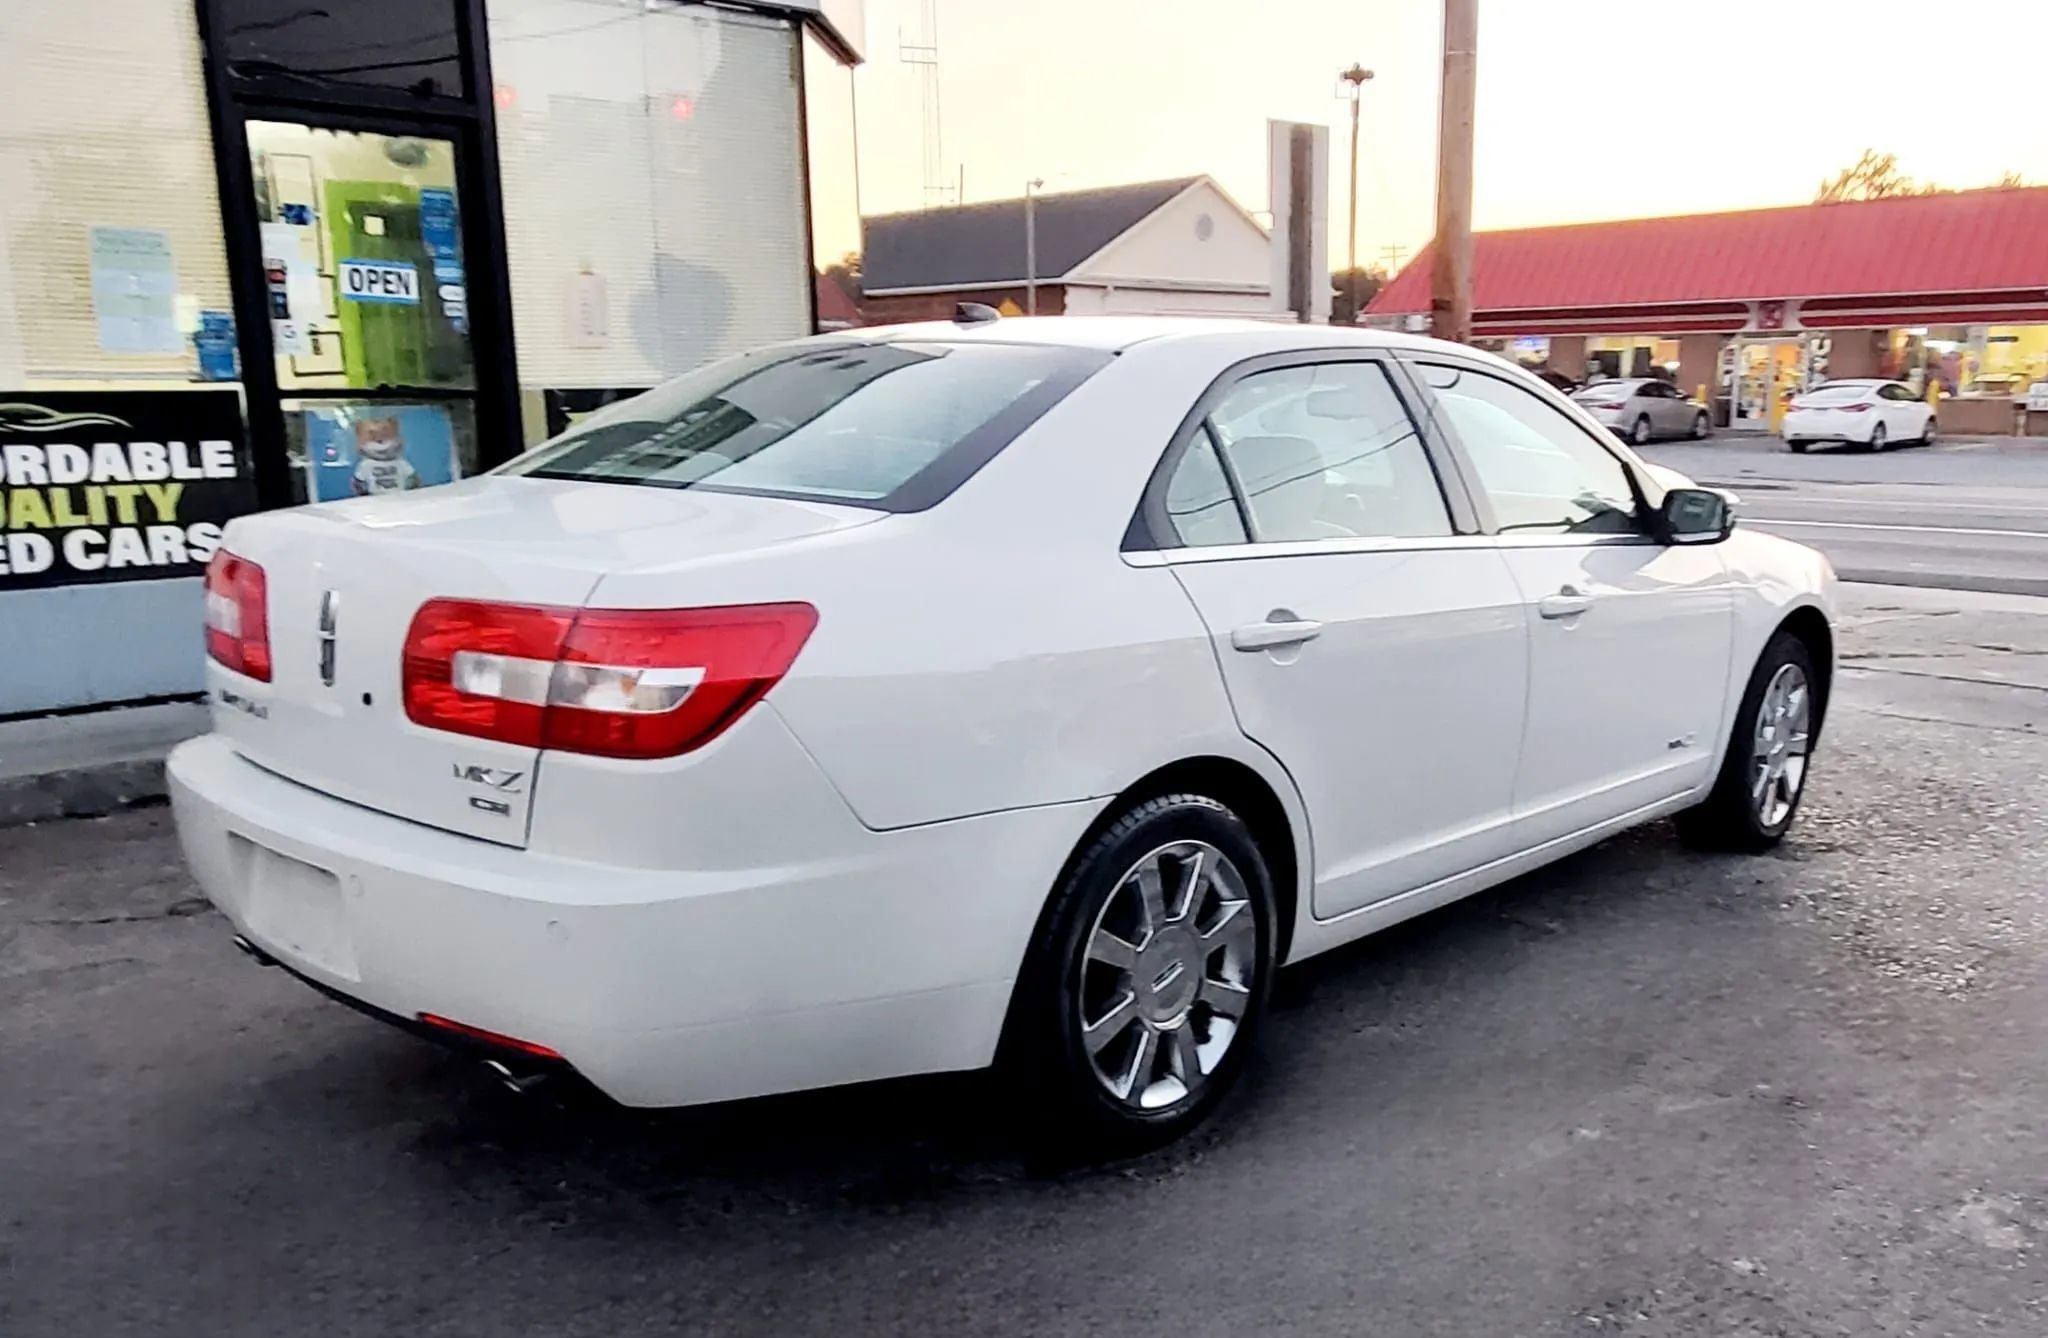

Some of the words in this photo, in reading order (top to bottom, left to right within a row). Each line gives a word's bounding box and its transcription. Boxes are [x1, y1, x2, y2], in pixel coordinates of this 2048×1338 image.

[349, 267, 411, 296] OPEN
[0, 439, 238, 486] RDABLE
[0, 482, 185, 530] ALITY
[62, 521, 223, 571] CARS
